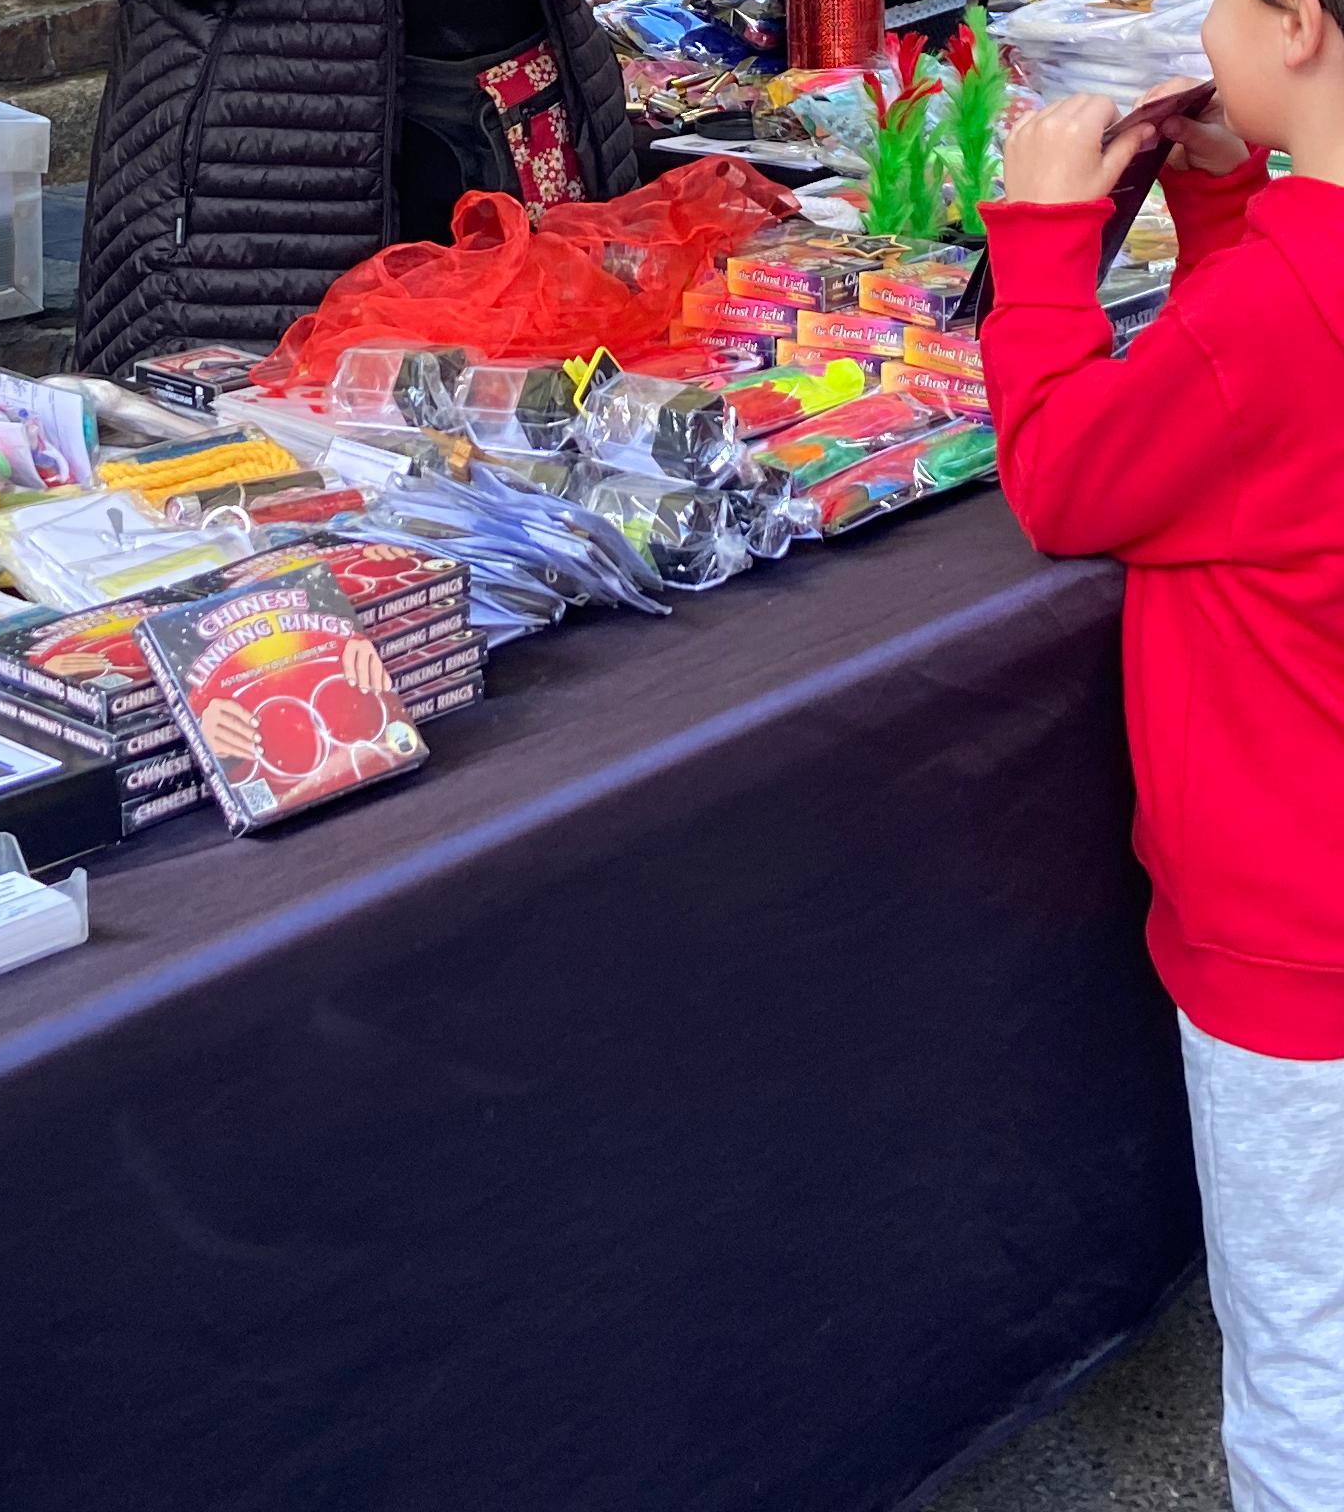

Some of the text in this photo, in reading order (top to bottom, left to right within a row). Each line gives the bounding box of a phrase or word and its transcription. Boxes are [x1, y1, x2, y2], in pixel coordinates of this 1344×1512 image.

[752, 269, 781, 286] Ghost
[783, 275, 810, 293] Light
[714, 302, 749, 317] Ghost
[752, 305, 785, 322] Light
[881, 287, 906, 306] Ghost
[908, 295, 931, 314] Light
[829, 323, 864, 340] Ghost
[867, 328, 898, 345] Light
[928, 341, 956, 361] Ghost
[959, 349, 983, 368] Ligh
[914, 372, 951, 391] Ghost
[954, 379, 986, 396] Ligh
[377, 589, 427, 620] LINKING
[428, 576, 464, 598] RINGS
[198, 590, 310, 638] CHINESE
[429, 614, 463, 637] RINGS
[187, 617, 274, 688] LINKING
[276, 612, 354, 639] RINGS
[445, 645, 480, 668] RINGS
[22, 665, 67, 703] LINKING
[437, 683, 474, 711] RINGS
[140, 637, 180, 705] CHINESE
[173, 701, 213, 774] LINKING
[126, 753, 193, 790] CHINESE
[134, 784, 199, 825] CHINESE
